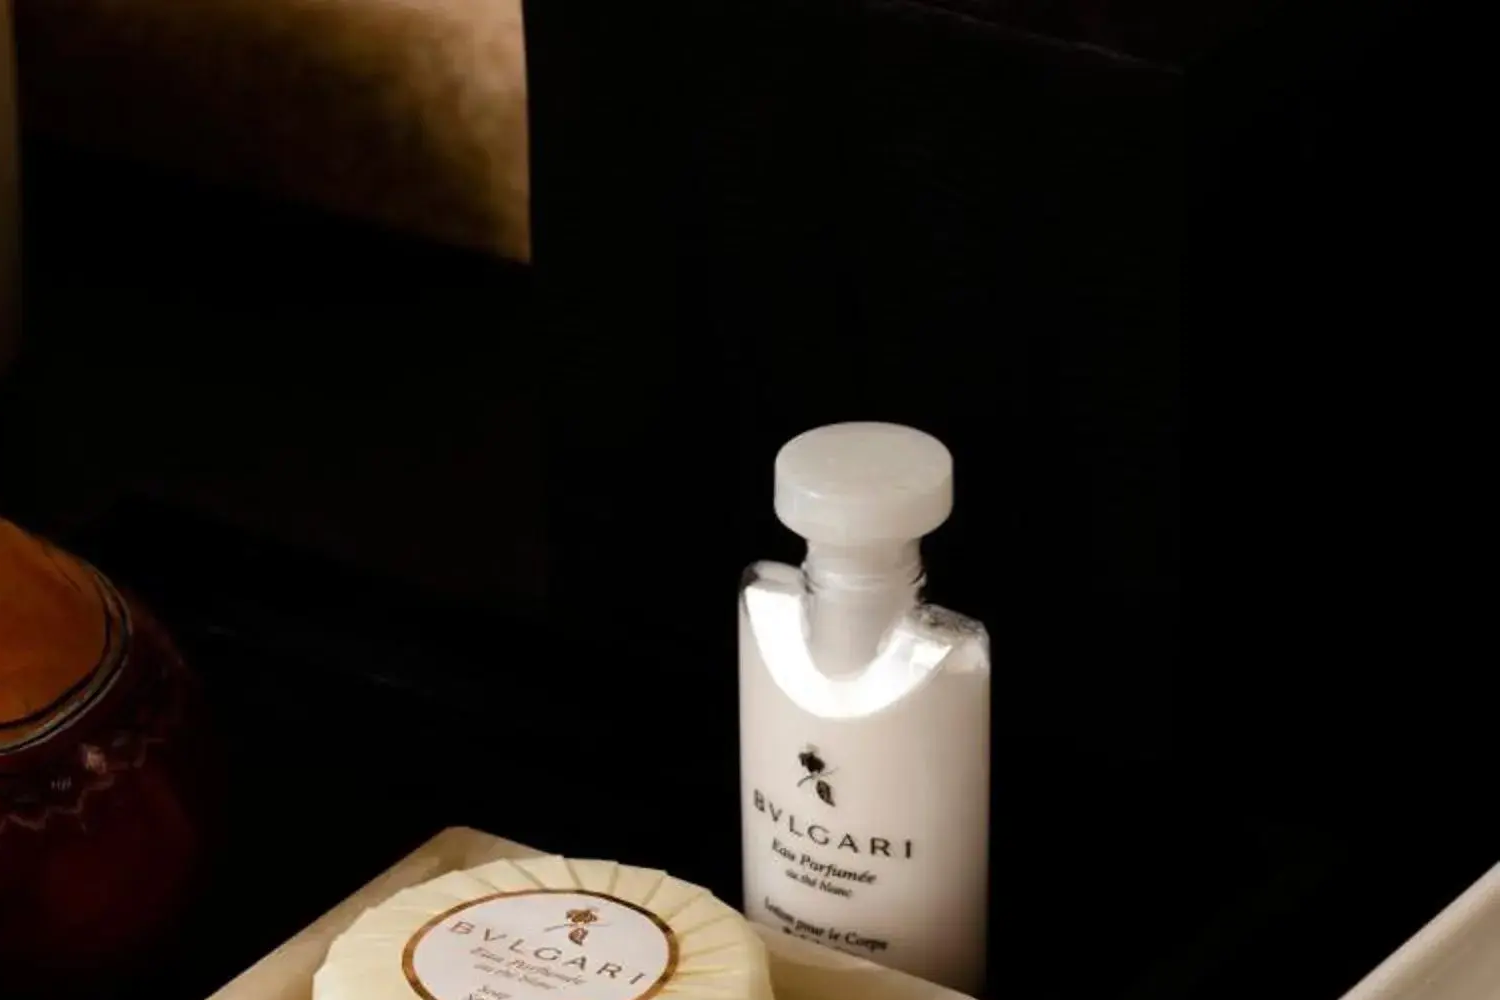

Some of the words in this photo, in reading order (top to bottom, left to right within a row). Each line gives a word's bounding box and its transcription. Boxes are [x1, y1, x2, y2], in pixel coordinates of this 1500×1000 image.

[753, 789, 913, 859] BVLGARI
[772, 837, 795, 861] Eau
[799, 852, 877, 885] Parfumée
[449, 921, 645, 985] BVLGARI
[764, 896, 795, 924] Lotion
[795, 919, 825, 937] pour
[828, 927, 842, 941] le
[844, 930, 890, 953] Corps
